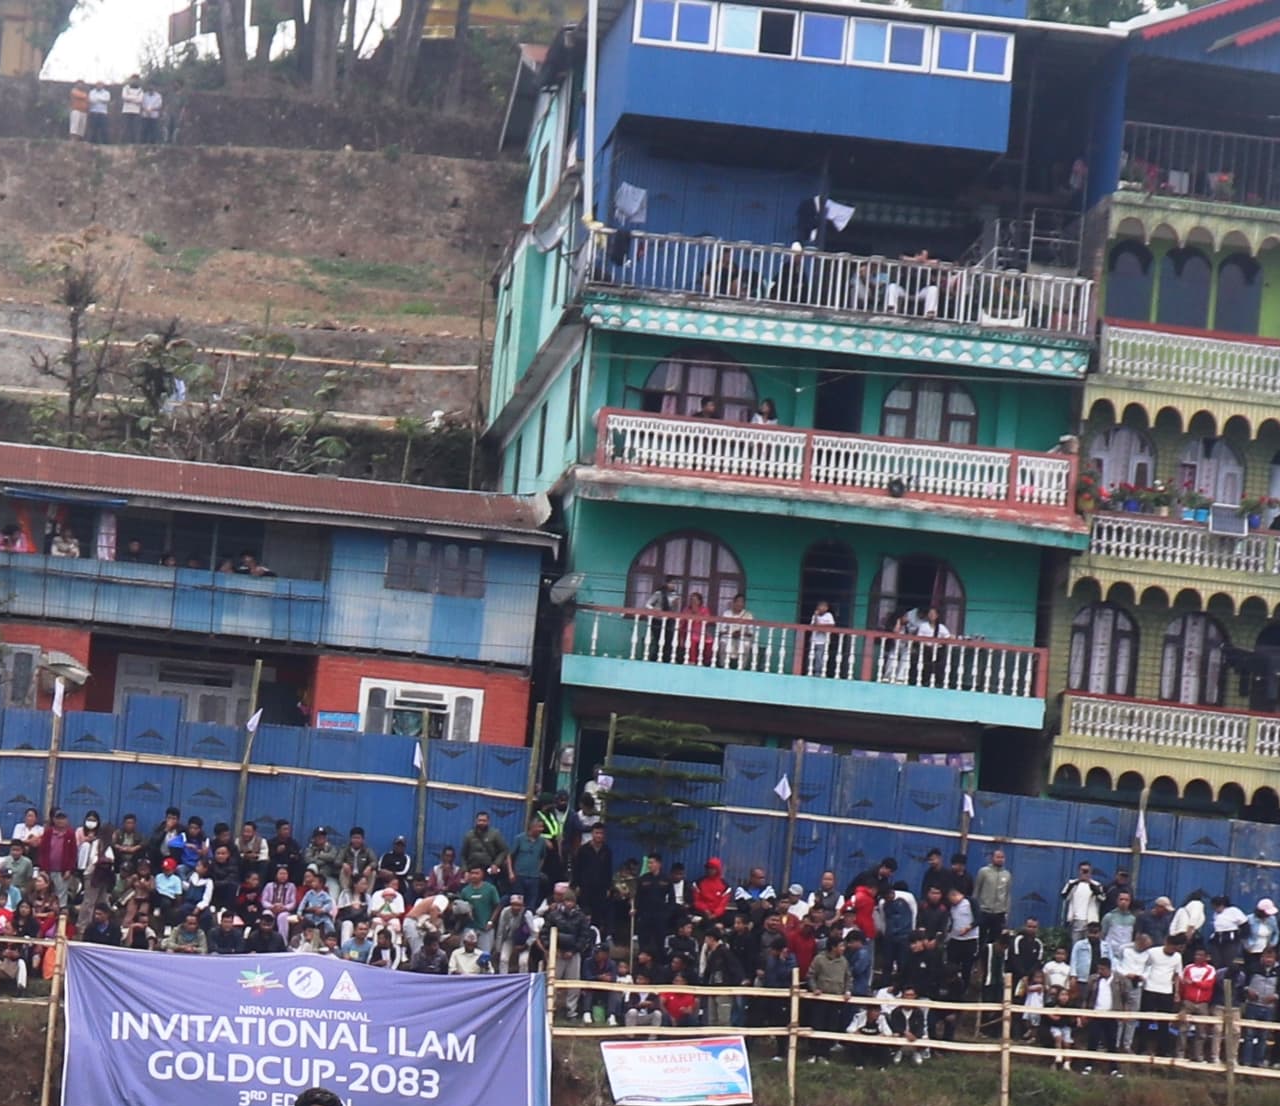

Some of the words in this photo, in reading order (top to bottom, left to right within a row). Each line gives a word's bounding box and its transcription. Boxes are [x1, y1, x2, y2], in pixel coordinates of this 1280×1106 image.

[111, 1011, 377, 1054] INVITATIONAL
[387, 1026, 476, 1064] ILAM
[239, 1005, 274, 1017] NRNA
[276, 1007, 372, 1023] INTERNATIONAL
[147, 1050, 440, 1099] GOLDCUP-2083
